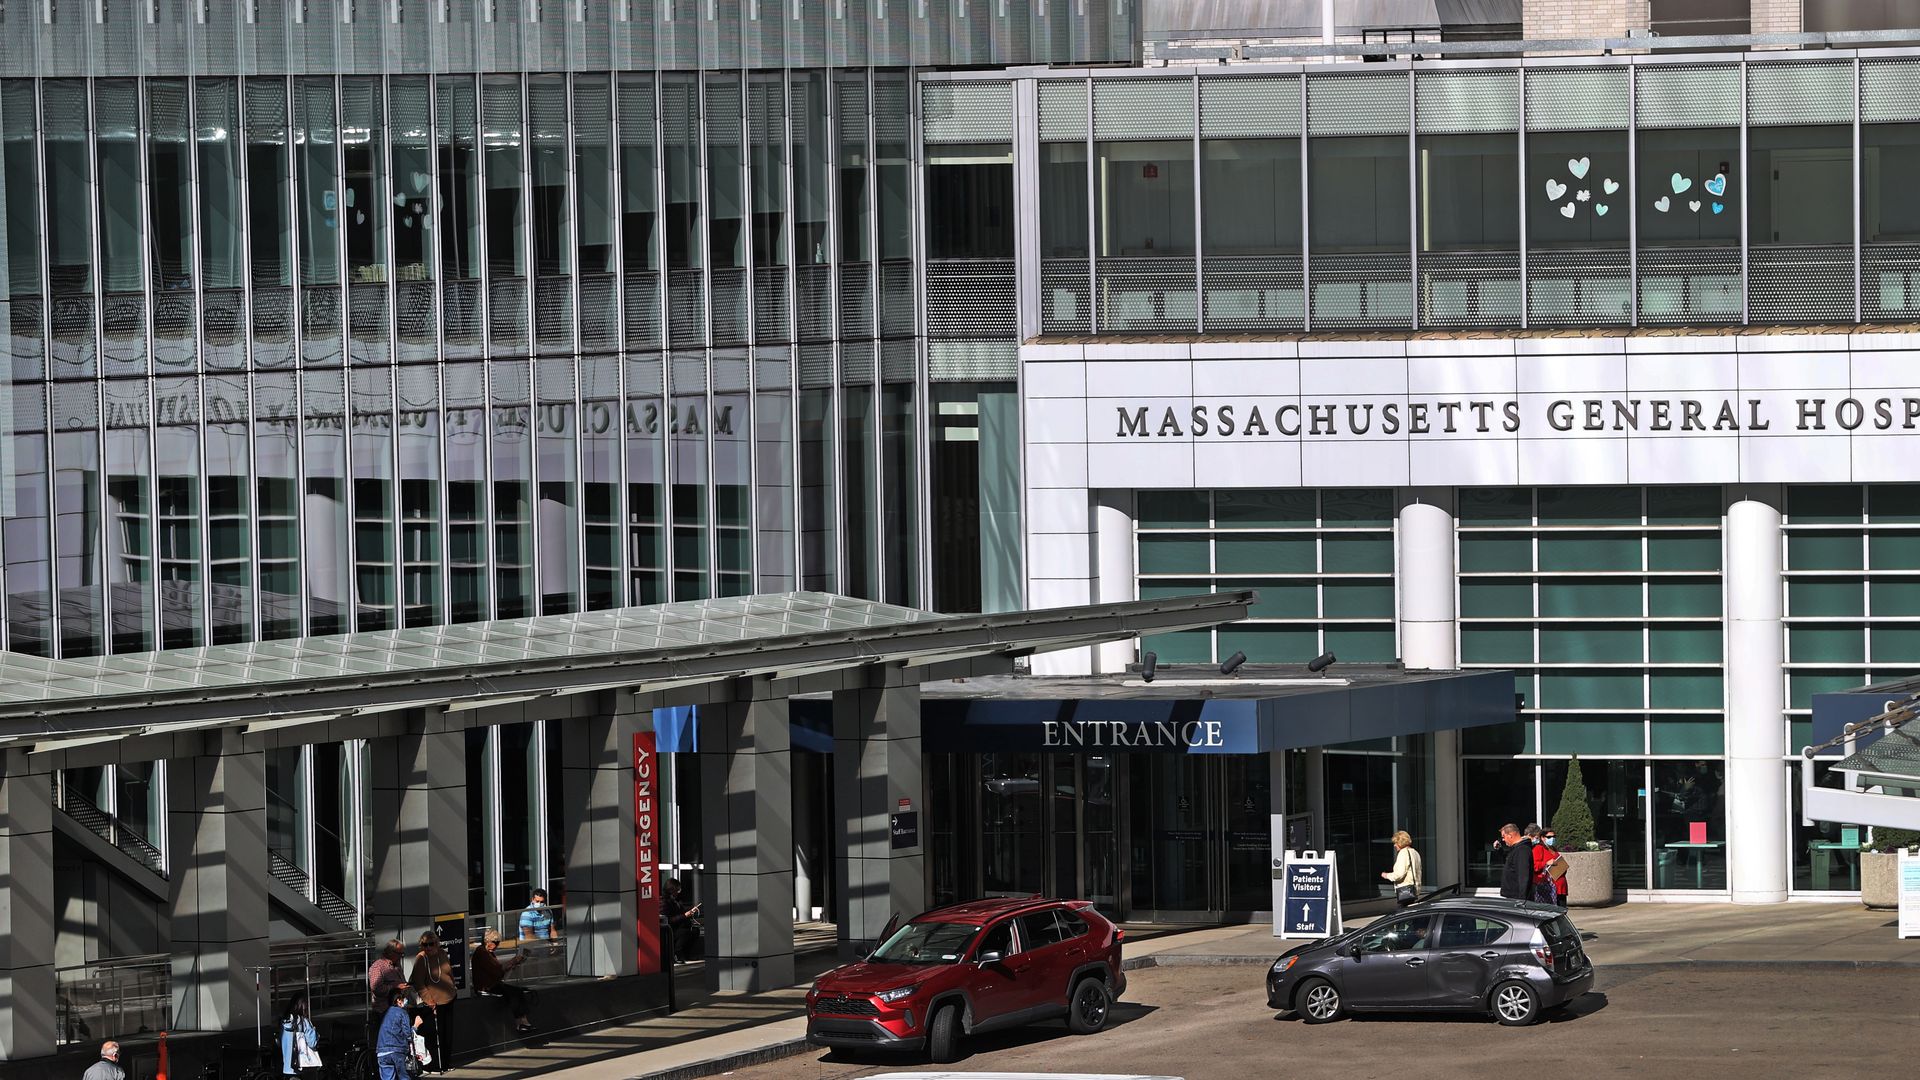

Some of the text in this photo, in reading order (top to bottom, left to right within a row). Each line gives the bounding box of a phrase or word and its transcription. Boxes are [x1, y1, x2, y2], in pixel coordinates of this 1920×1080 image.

[1116, 398, 1920, 437] MASSACHUSETTS GENERAL HOSP
[1042, 720, 1224, 747] ENTRANCE
[638, 747, 652, 899] EMERGENCY
[1296, 922, 1314, 930] Staff
